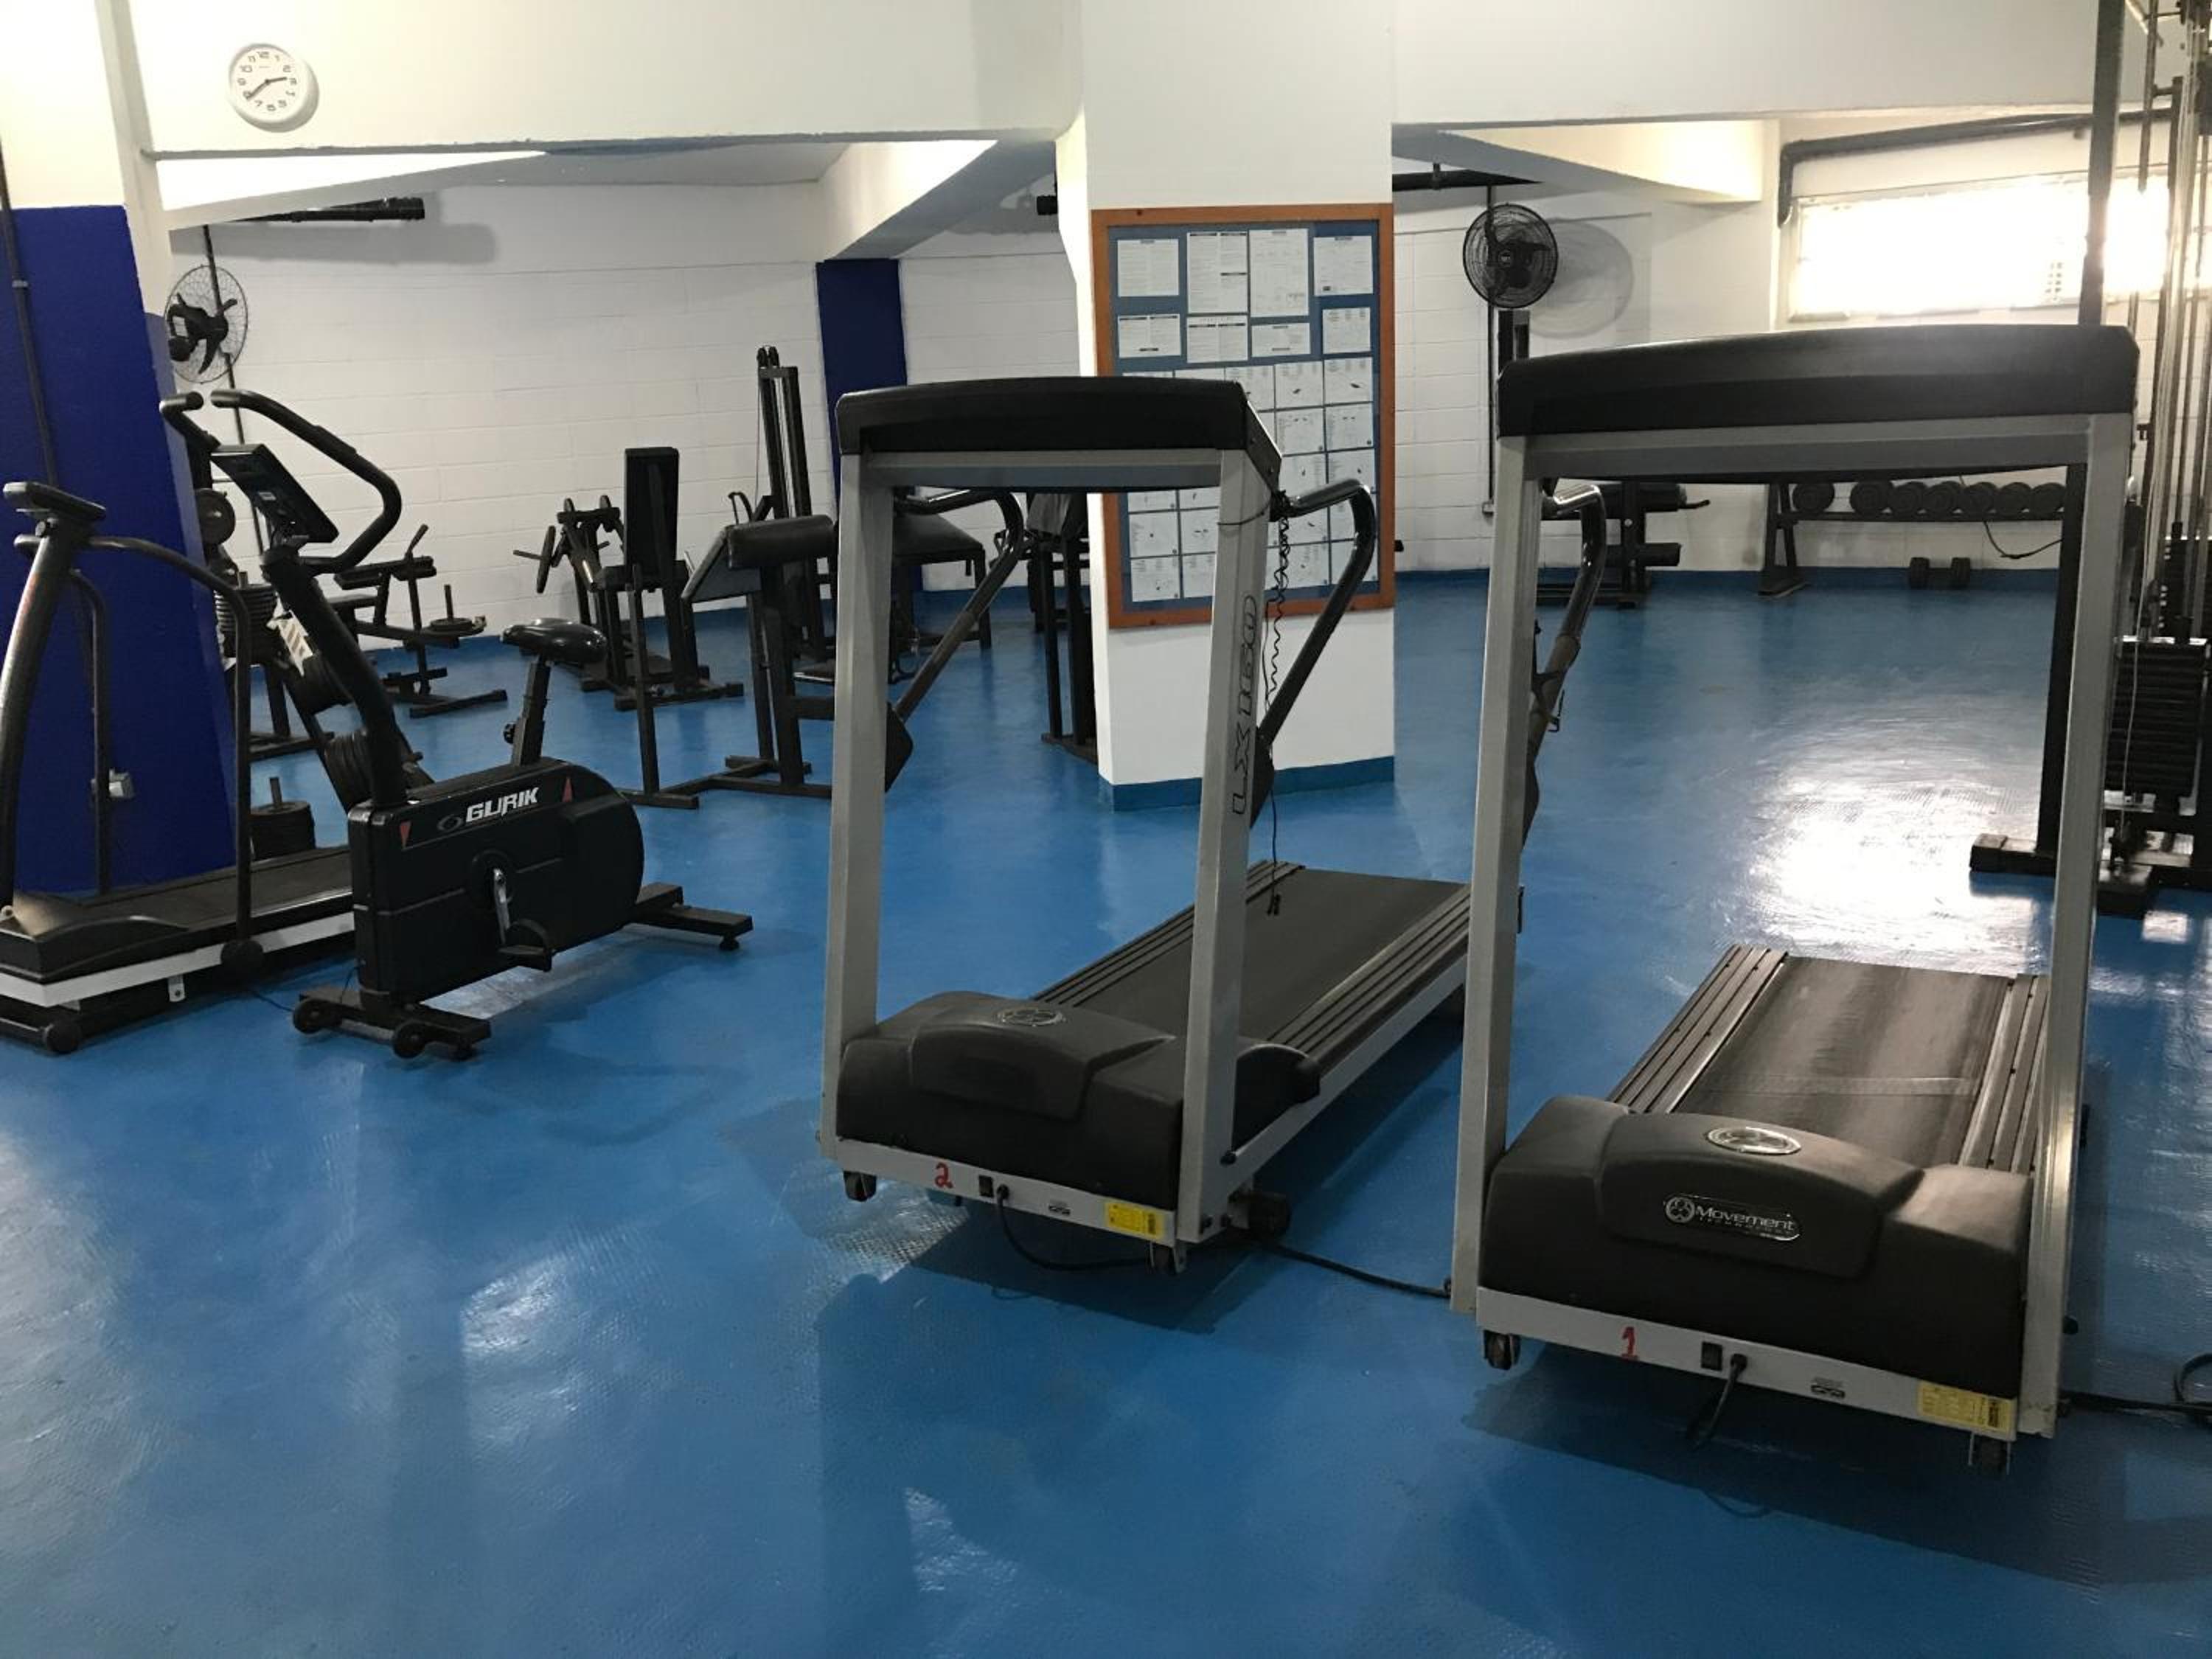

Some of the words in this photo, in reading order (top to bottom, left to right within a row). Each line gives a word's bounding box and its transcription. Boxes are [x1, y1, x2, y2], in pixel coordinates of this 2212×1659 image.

[257, 51, 270, 59] 12
[239, 64, 252, 73] 10
[282, 64, 291, 72] 2
[465, 787, 540, 823] GURIK
[934, 1163, 953, 1189] 2
[1697, 1206, 1795, 1231] Movement
[1621, 1326, 1639, 1361] 1
